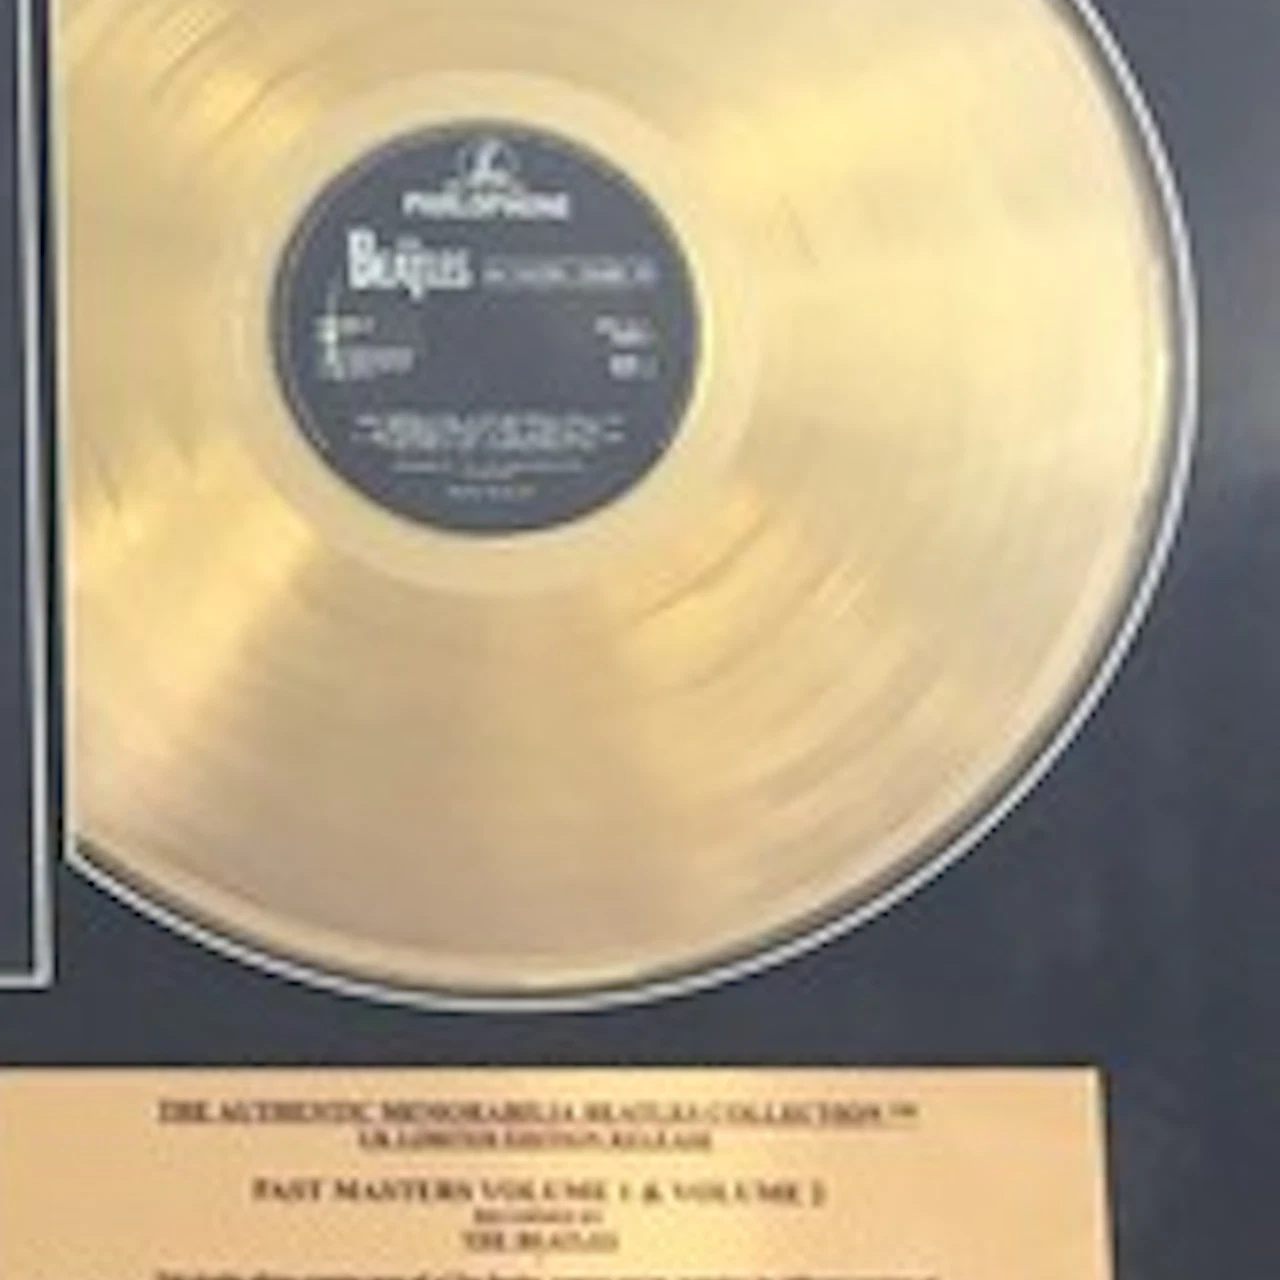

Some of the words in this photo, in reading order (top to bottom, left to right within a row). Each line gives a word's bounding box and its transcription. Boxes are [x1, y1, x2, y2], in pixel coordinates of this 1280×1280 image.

[251, 1178, 322, 1202] PAST
[334, 1178, 474, 1203] MASTERS
[480, 1179, 608, 1203] VOLUME
